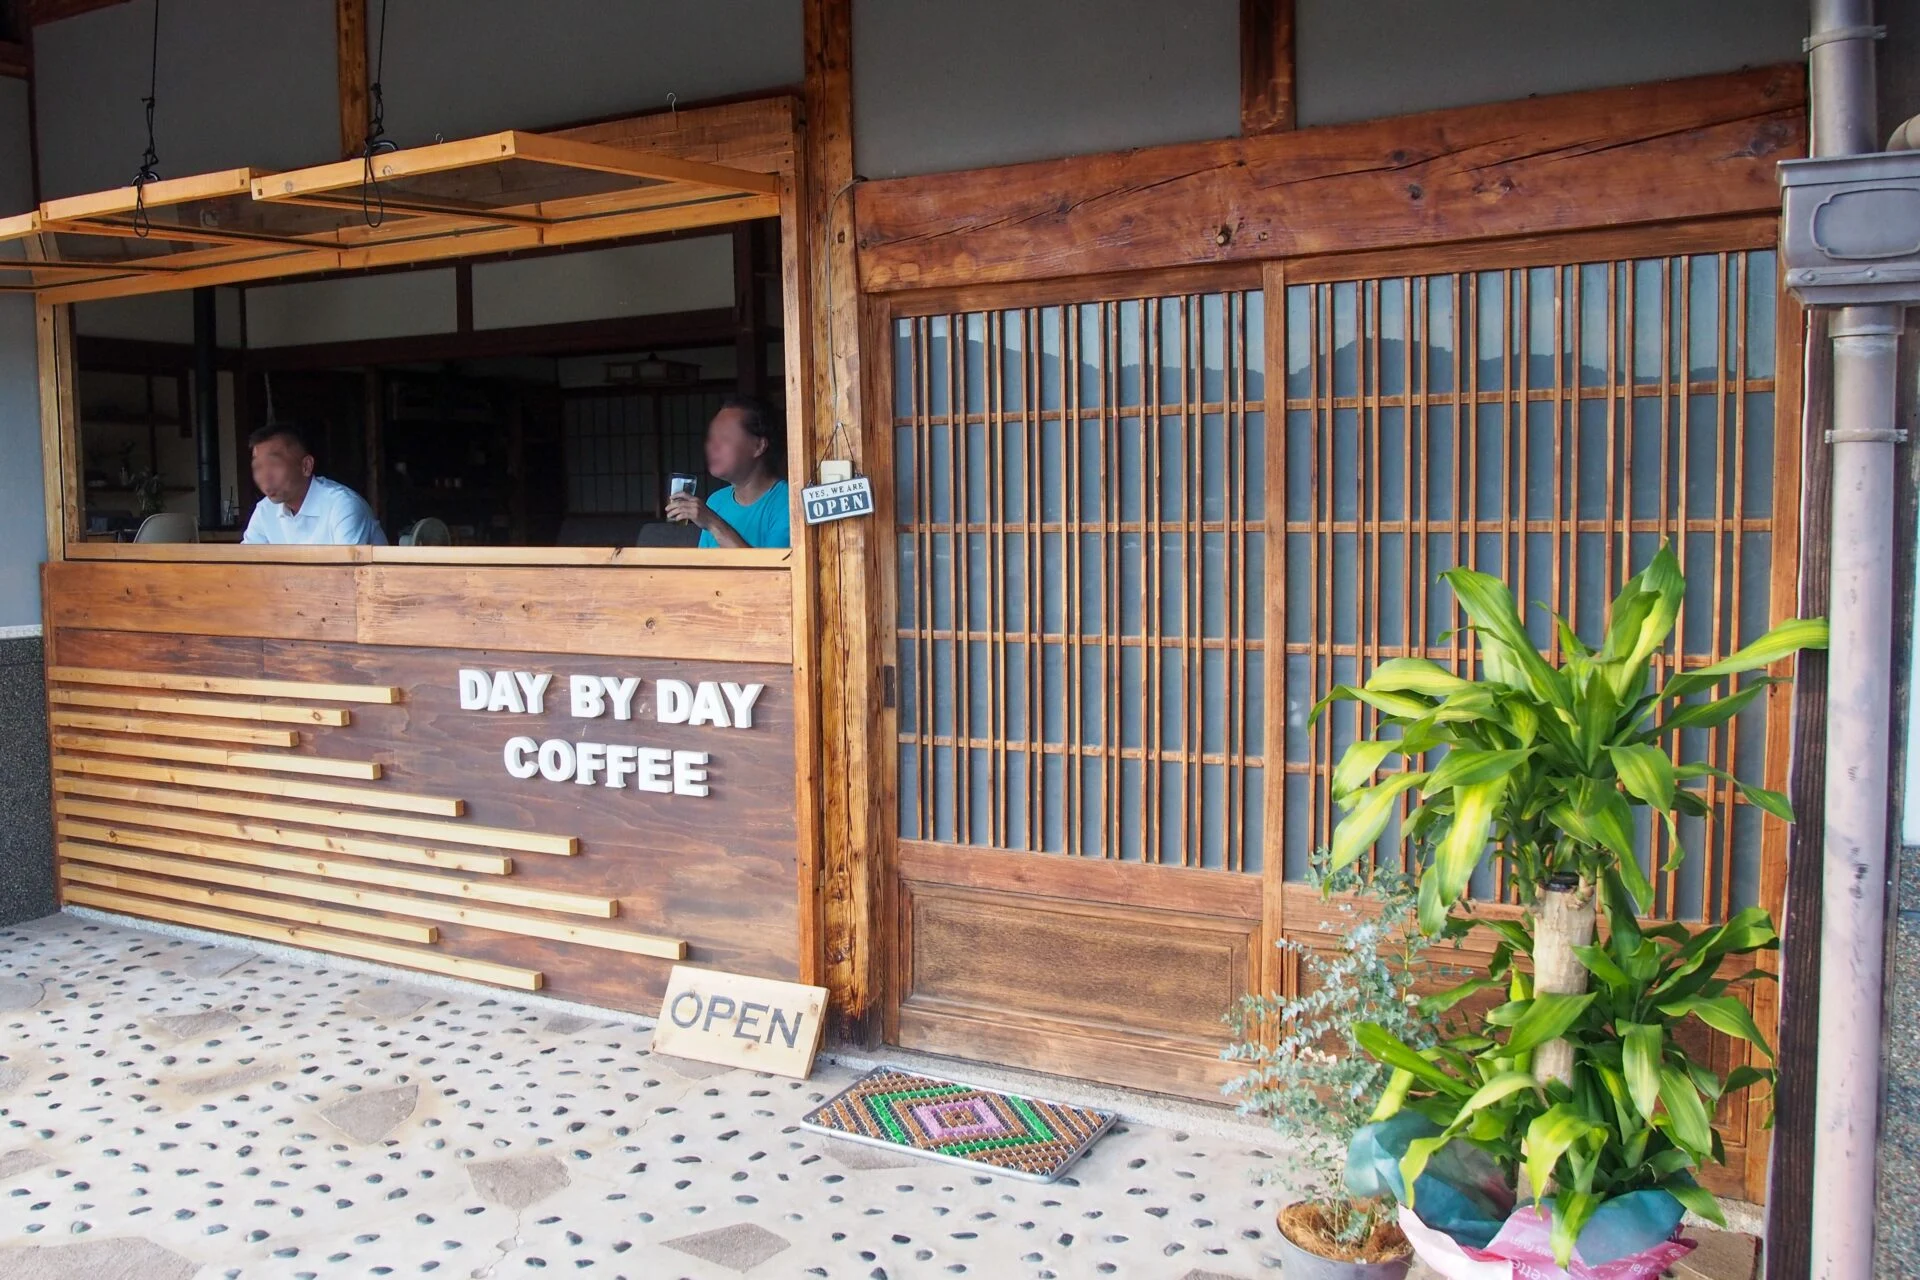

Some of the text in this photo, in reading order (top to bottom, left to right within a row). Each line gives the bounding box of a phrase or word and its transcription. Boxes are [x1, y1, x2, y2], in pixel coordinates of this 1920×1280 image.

[812, 494, 864, 517] OPEN
[831, 486, 845, 494] WE
[846, 482, 864, 491] ARE
[459, 669, 765, 728] DAY BY DAY
[504, 736, 709, 797] COFFEE
[670, 991, 803, 1048] OPEN
